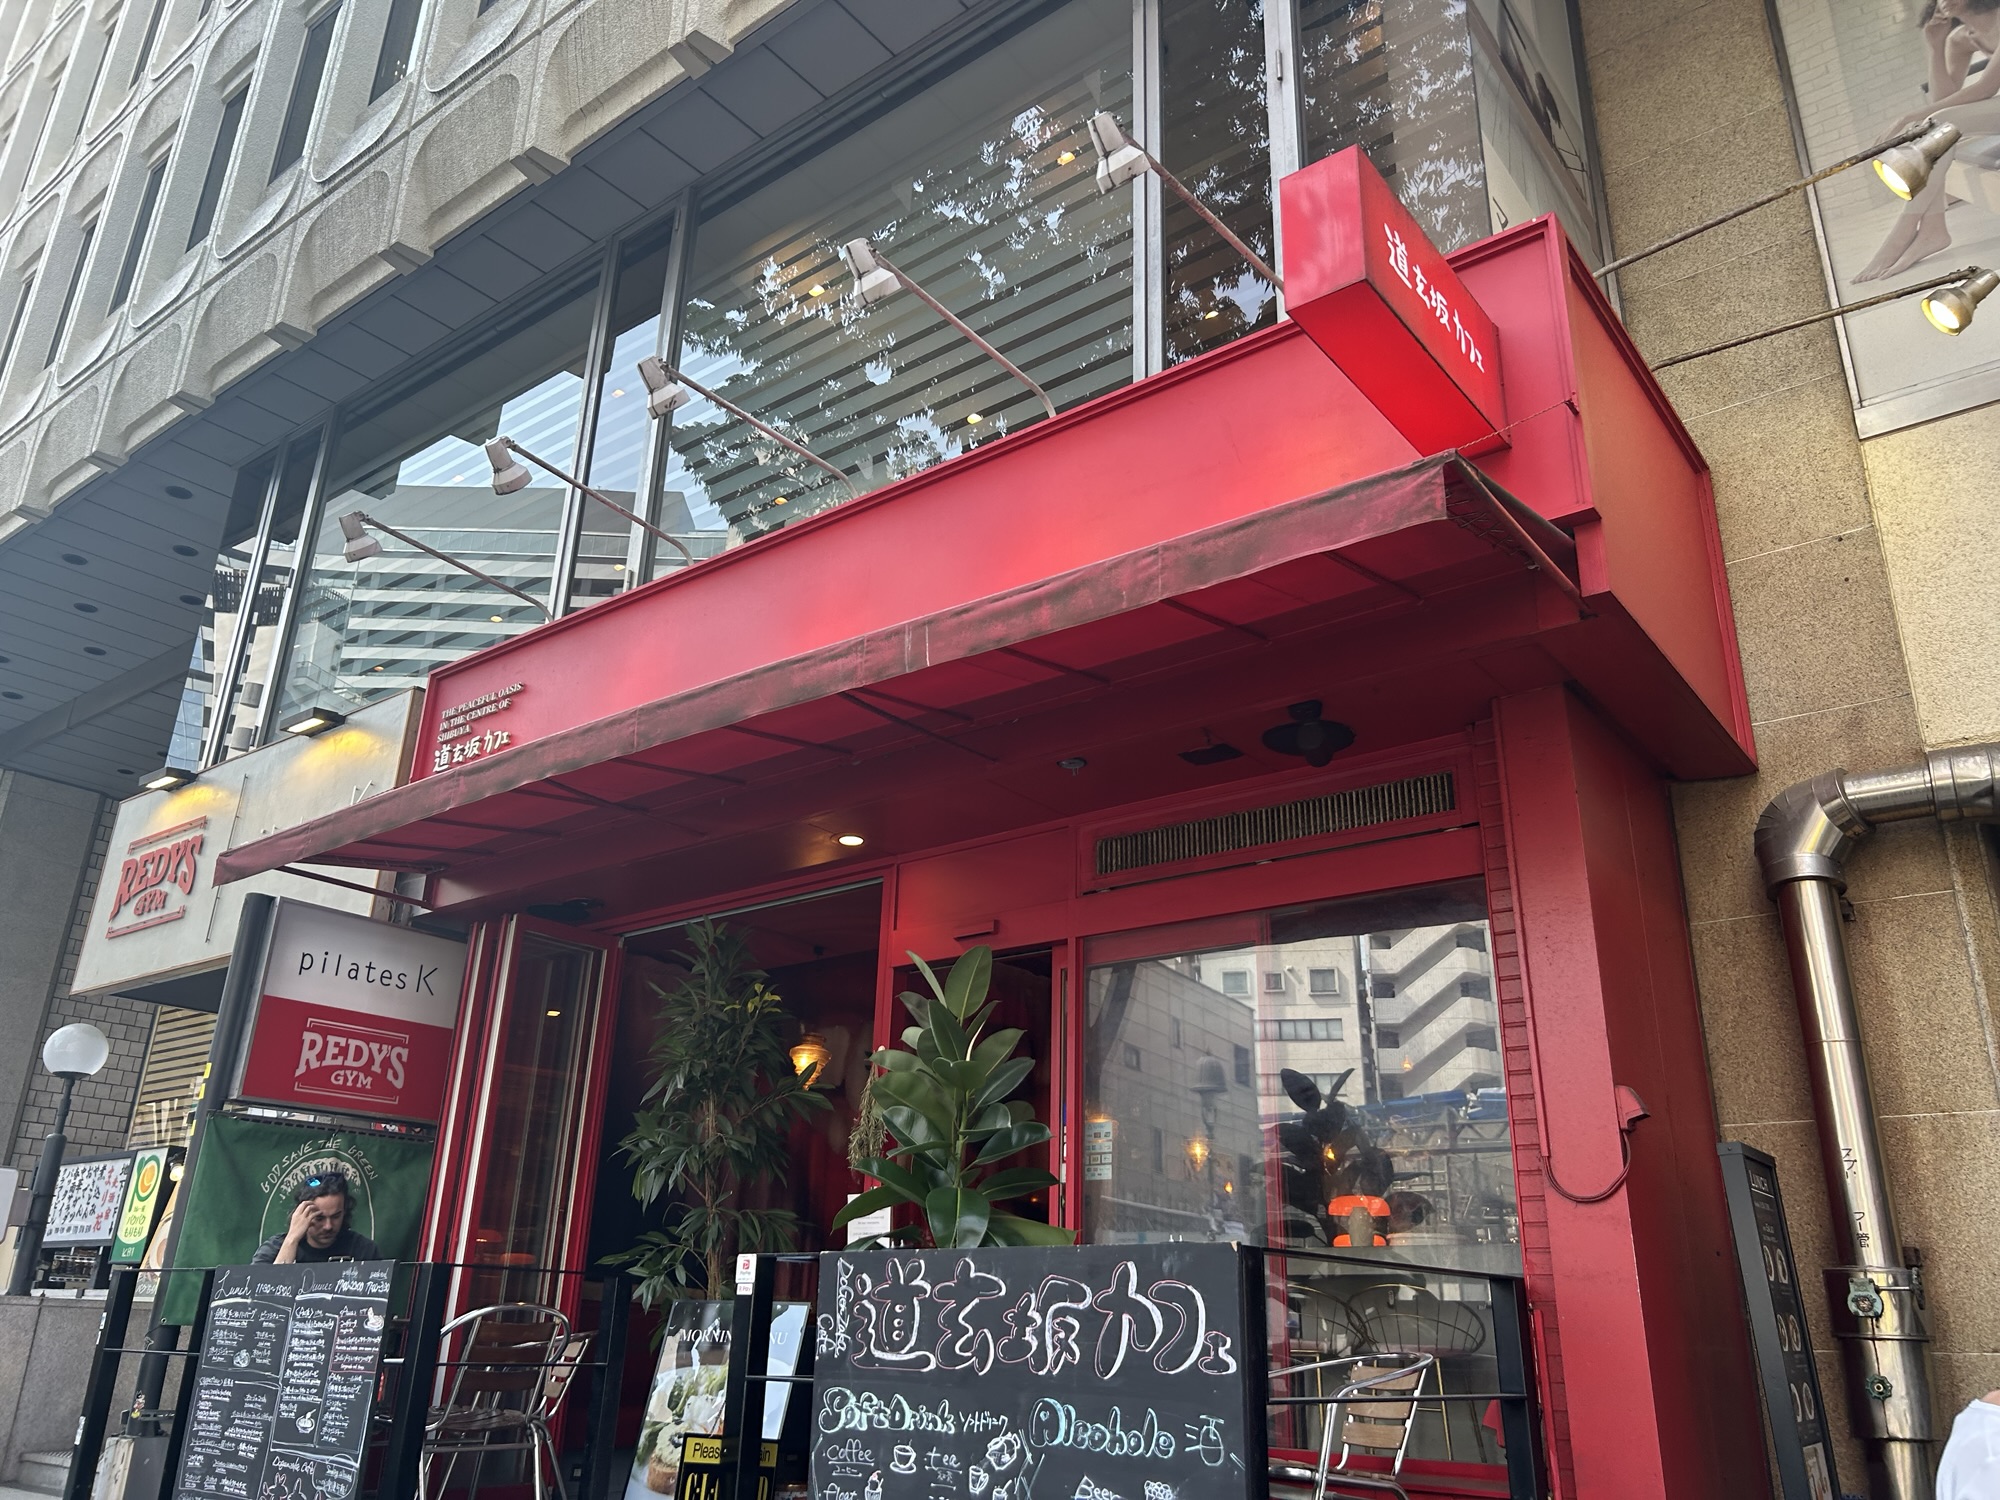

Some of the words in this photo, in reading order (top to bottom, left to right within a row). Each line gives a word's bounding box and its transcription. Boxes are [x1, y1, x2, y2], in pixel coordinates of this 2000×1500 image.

[1384, 223, 1485, 373] 道玄坂カフェ
[439, 721, 450, 731] IN
[450, 715, 468, 727] THE
[466, 703, 499, 721] CENTRE
[498, 698, 512, 709] OF
[441, 706, 459, 719] THE
[457, 691, 498, 713] PEACEFUL
[498, 682, 524, 698] OASIS
[437, 724, 472, 743] SHIBUYA
[432, 729, 511, 772] 道玄坂カフェ
[109, 834, 203, 922] REDY'S
[134, 889, 168, 916] GYM
[299, 951, 407, 989] pilates
[416, 964, 438, 996] K
[295, 1031, 409, 1089] REDY'S
[331, 1069, 373, 1089] GYM
[260, 1164, 281, 1193] GOD
[282, 1140, 313, 1168] SAVE
[318, 1137, 341, 1149] THE
[348, 1145, 378, 1180] GREEN
[214, 1270, 252, 1299] Lunch
[298, 1268, 333, 1295] Dinner
[850, 1257, 1237, 1379] 道玄坂カフェ
[680, 1329, 731, 1344] MORNIN
[770, 1332, 788, 1345] NU
[1029, 1398, 1175, 1458] Alcohole
[692, 1442, 722, 1459] Pleas
[926, 1447, 961, 1468] tea
[1074, 1475, 1119, 1500] Beer
